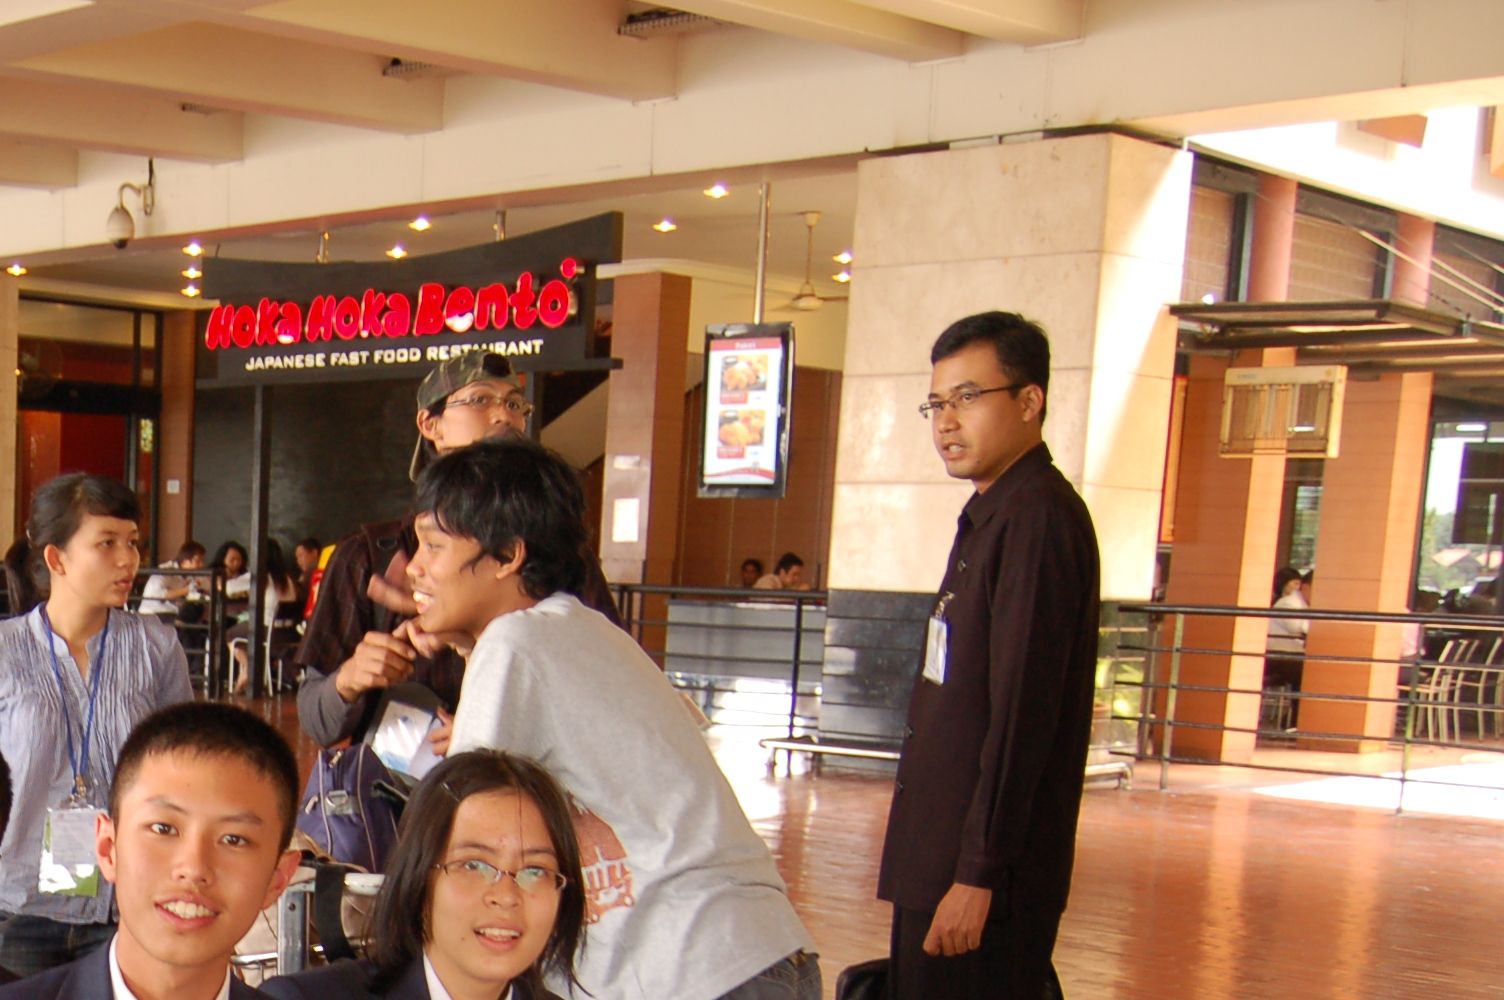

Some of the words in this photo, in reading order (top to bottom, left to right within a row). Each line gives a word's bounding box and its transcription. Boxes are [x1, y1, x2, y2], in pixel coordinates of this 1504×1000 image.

[413, 271, 570, 335] Bento
[245, 353, 327, 372] JAPANESE
[330, 350, 368, 367] FAST
[374, 347, 422, 364] FOOD
